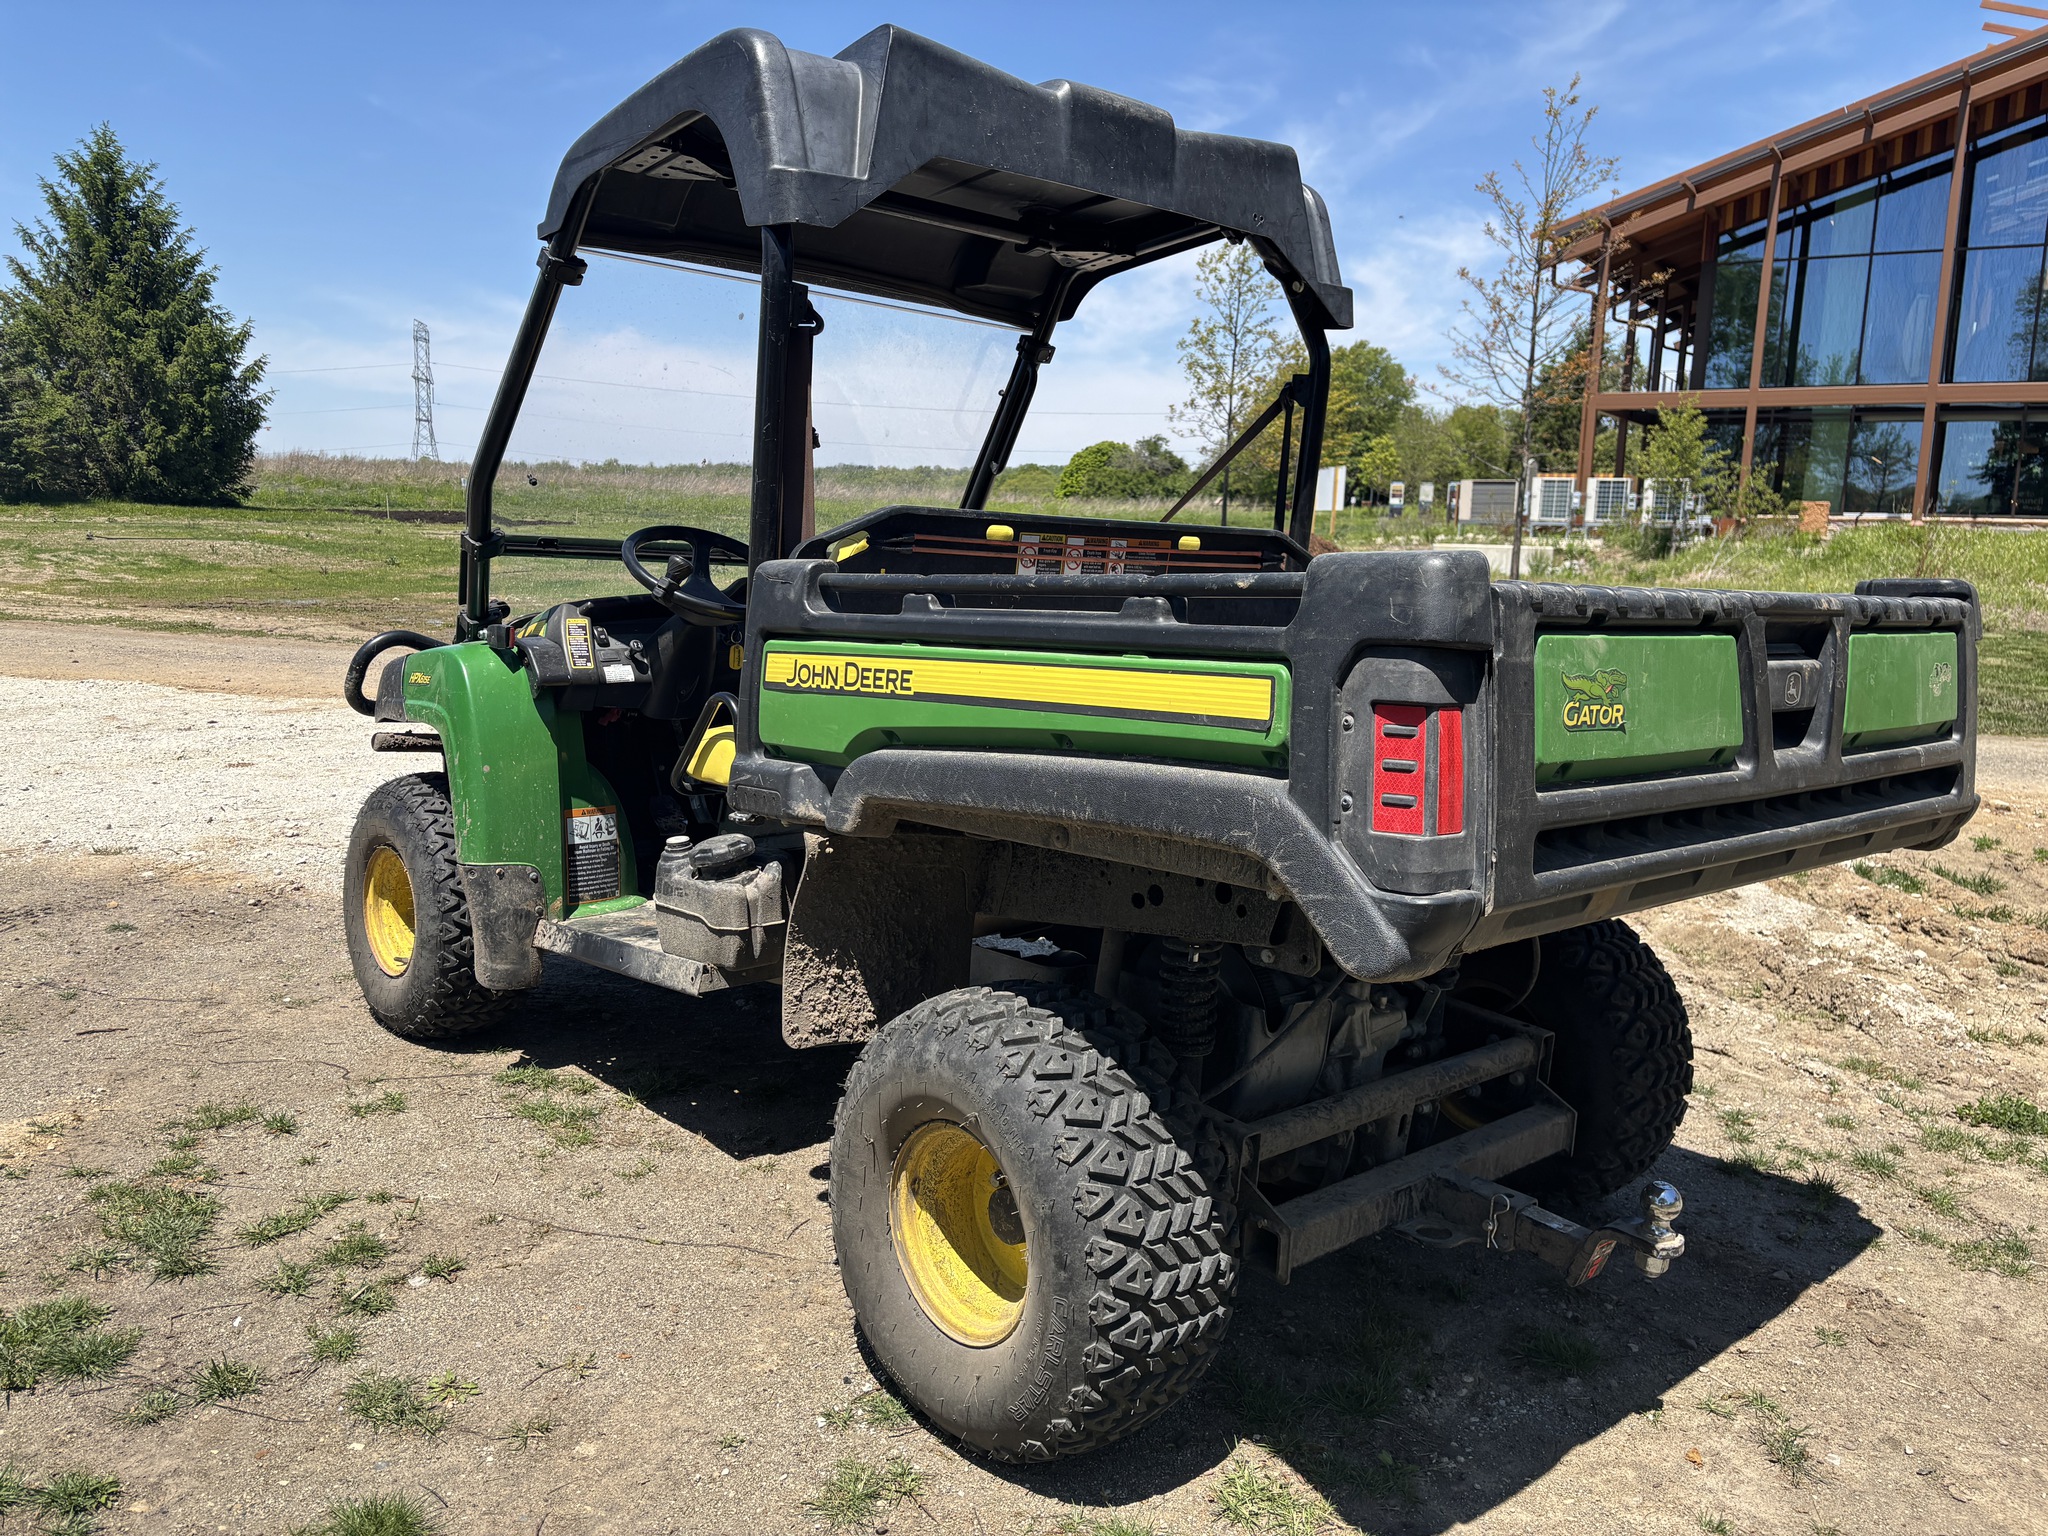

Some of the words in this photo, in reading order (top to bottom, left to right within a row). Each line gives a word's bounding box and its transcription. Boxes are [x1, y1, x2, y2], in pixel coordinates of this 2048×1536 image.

[2019, 496, 2044, 506] ouncil
[786, 659, 839, 687] JOHN
[844, 661, 914, 692] DEERE
[1562, 701, 1624, 728] GATOR
[1008, 1296, 1069, 1421] CARLSTAR
